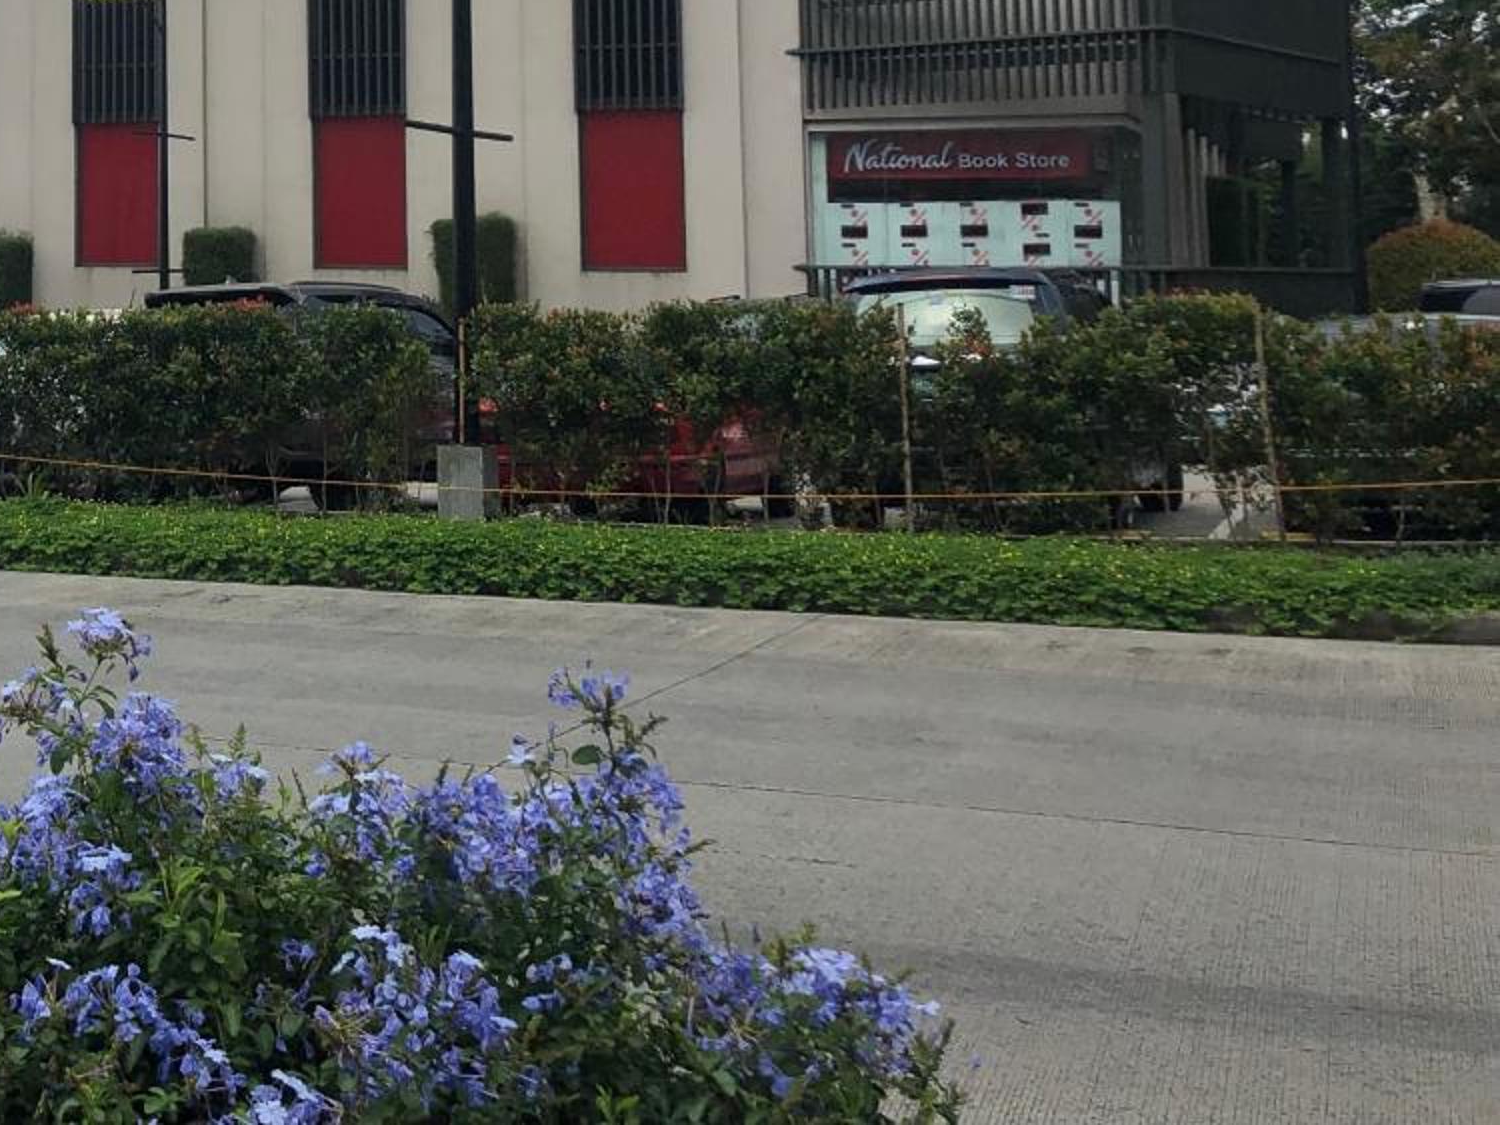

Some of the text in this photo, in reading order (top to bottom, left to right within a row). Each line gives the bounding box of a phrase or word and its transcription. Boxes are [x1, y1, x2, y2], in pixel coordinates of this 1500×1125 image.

[843, 138, 1071, 173] National Book Store
